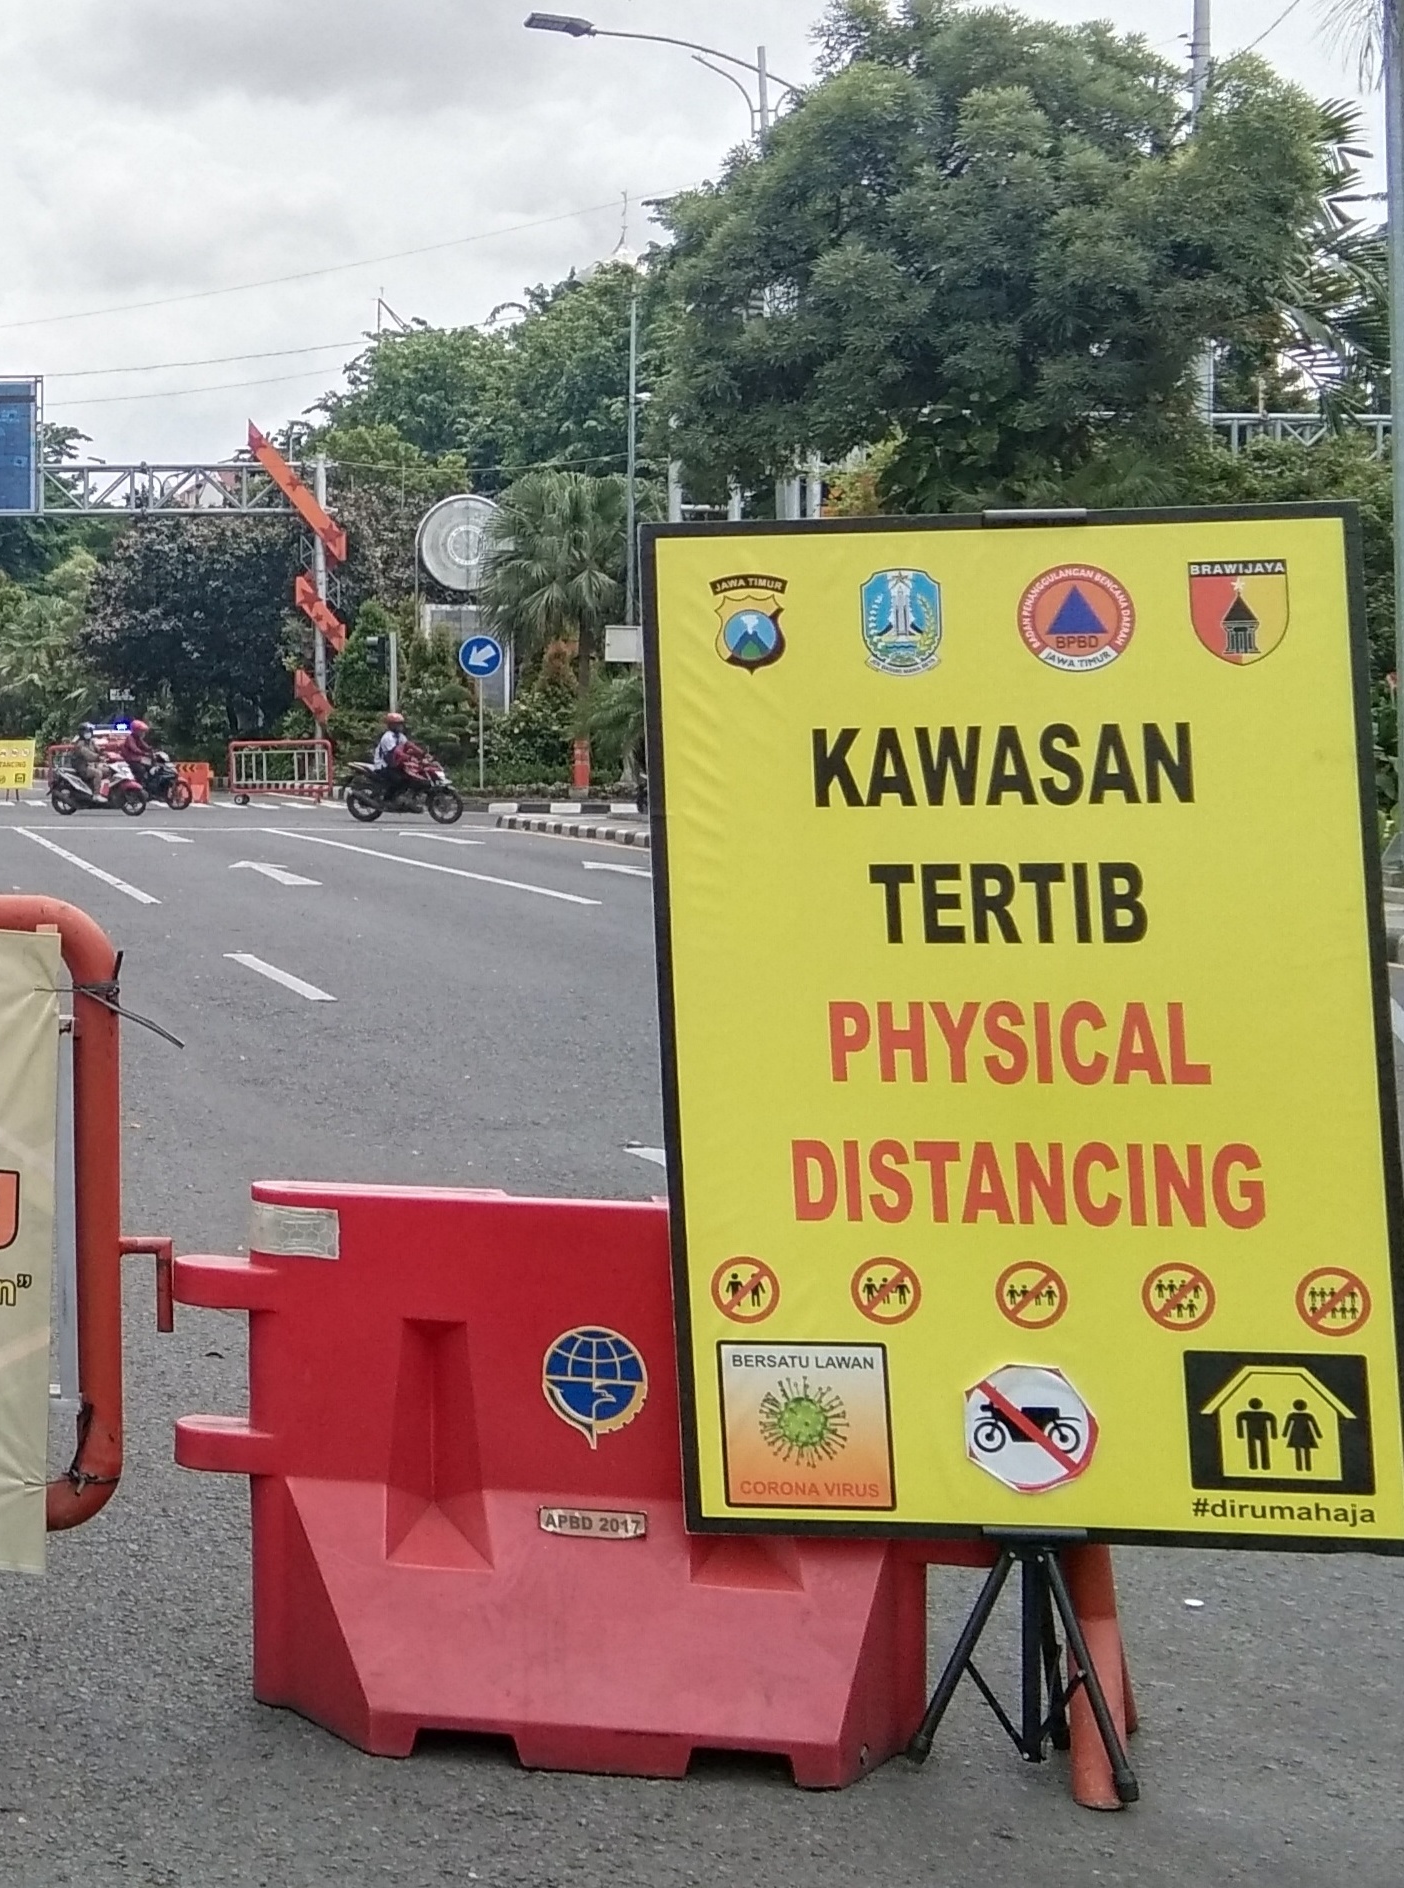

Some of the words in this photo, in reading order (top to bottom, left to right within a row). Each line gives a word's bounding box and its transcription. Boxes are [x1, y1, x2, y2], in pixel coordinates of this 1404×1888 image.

[1190, 562, 1285, 575] BRAWIJAYA
[716, 579, 745, 592] JAWA
[748, 578, 783, 590] TIMUR
[1022, 568, 1094, 616] PENANGGULANGAN
[1094, 572, 1129, 609] BENCANA
[1022, 618, 1041, 649] BADAN
[1056, 635, 1099, 649] BPBD
[1115, 610, 1131, 646] DAERAH
[1044, 651, 1076, 667] JAWA
[1077, 651, 1112, 667] TIMUR
[812, 722, 1196, 808] KAWASAN
[868, 862, 1148, 944] TERTIB
[828, 1001, 1212, 1086] PHYSICAL
[791, 1139, 1266, 1230] DISTANCING
[732, 1354, 809, 1369] BERSATU
[815, 1355, 874, 1370] LAWAN
[740, 1481, 820, 1496] CORONA
[824, 1482, 879, 1498] VIRUS
[545, 1513, 593, 1531] APBD
[599, 1517, 641, 1534] 2017
[1192, 1498, 1376, 1529] #dirumahaja
